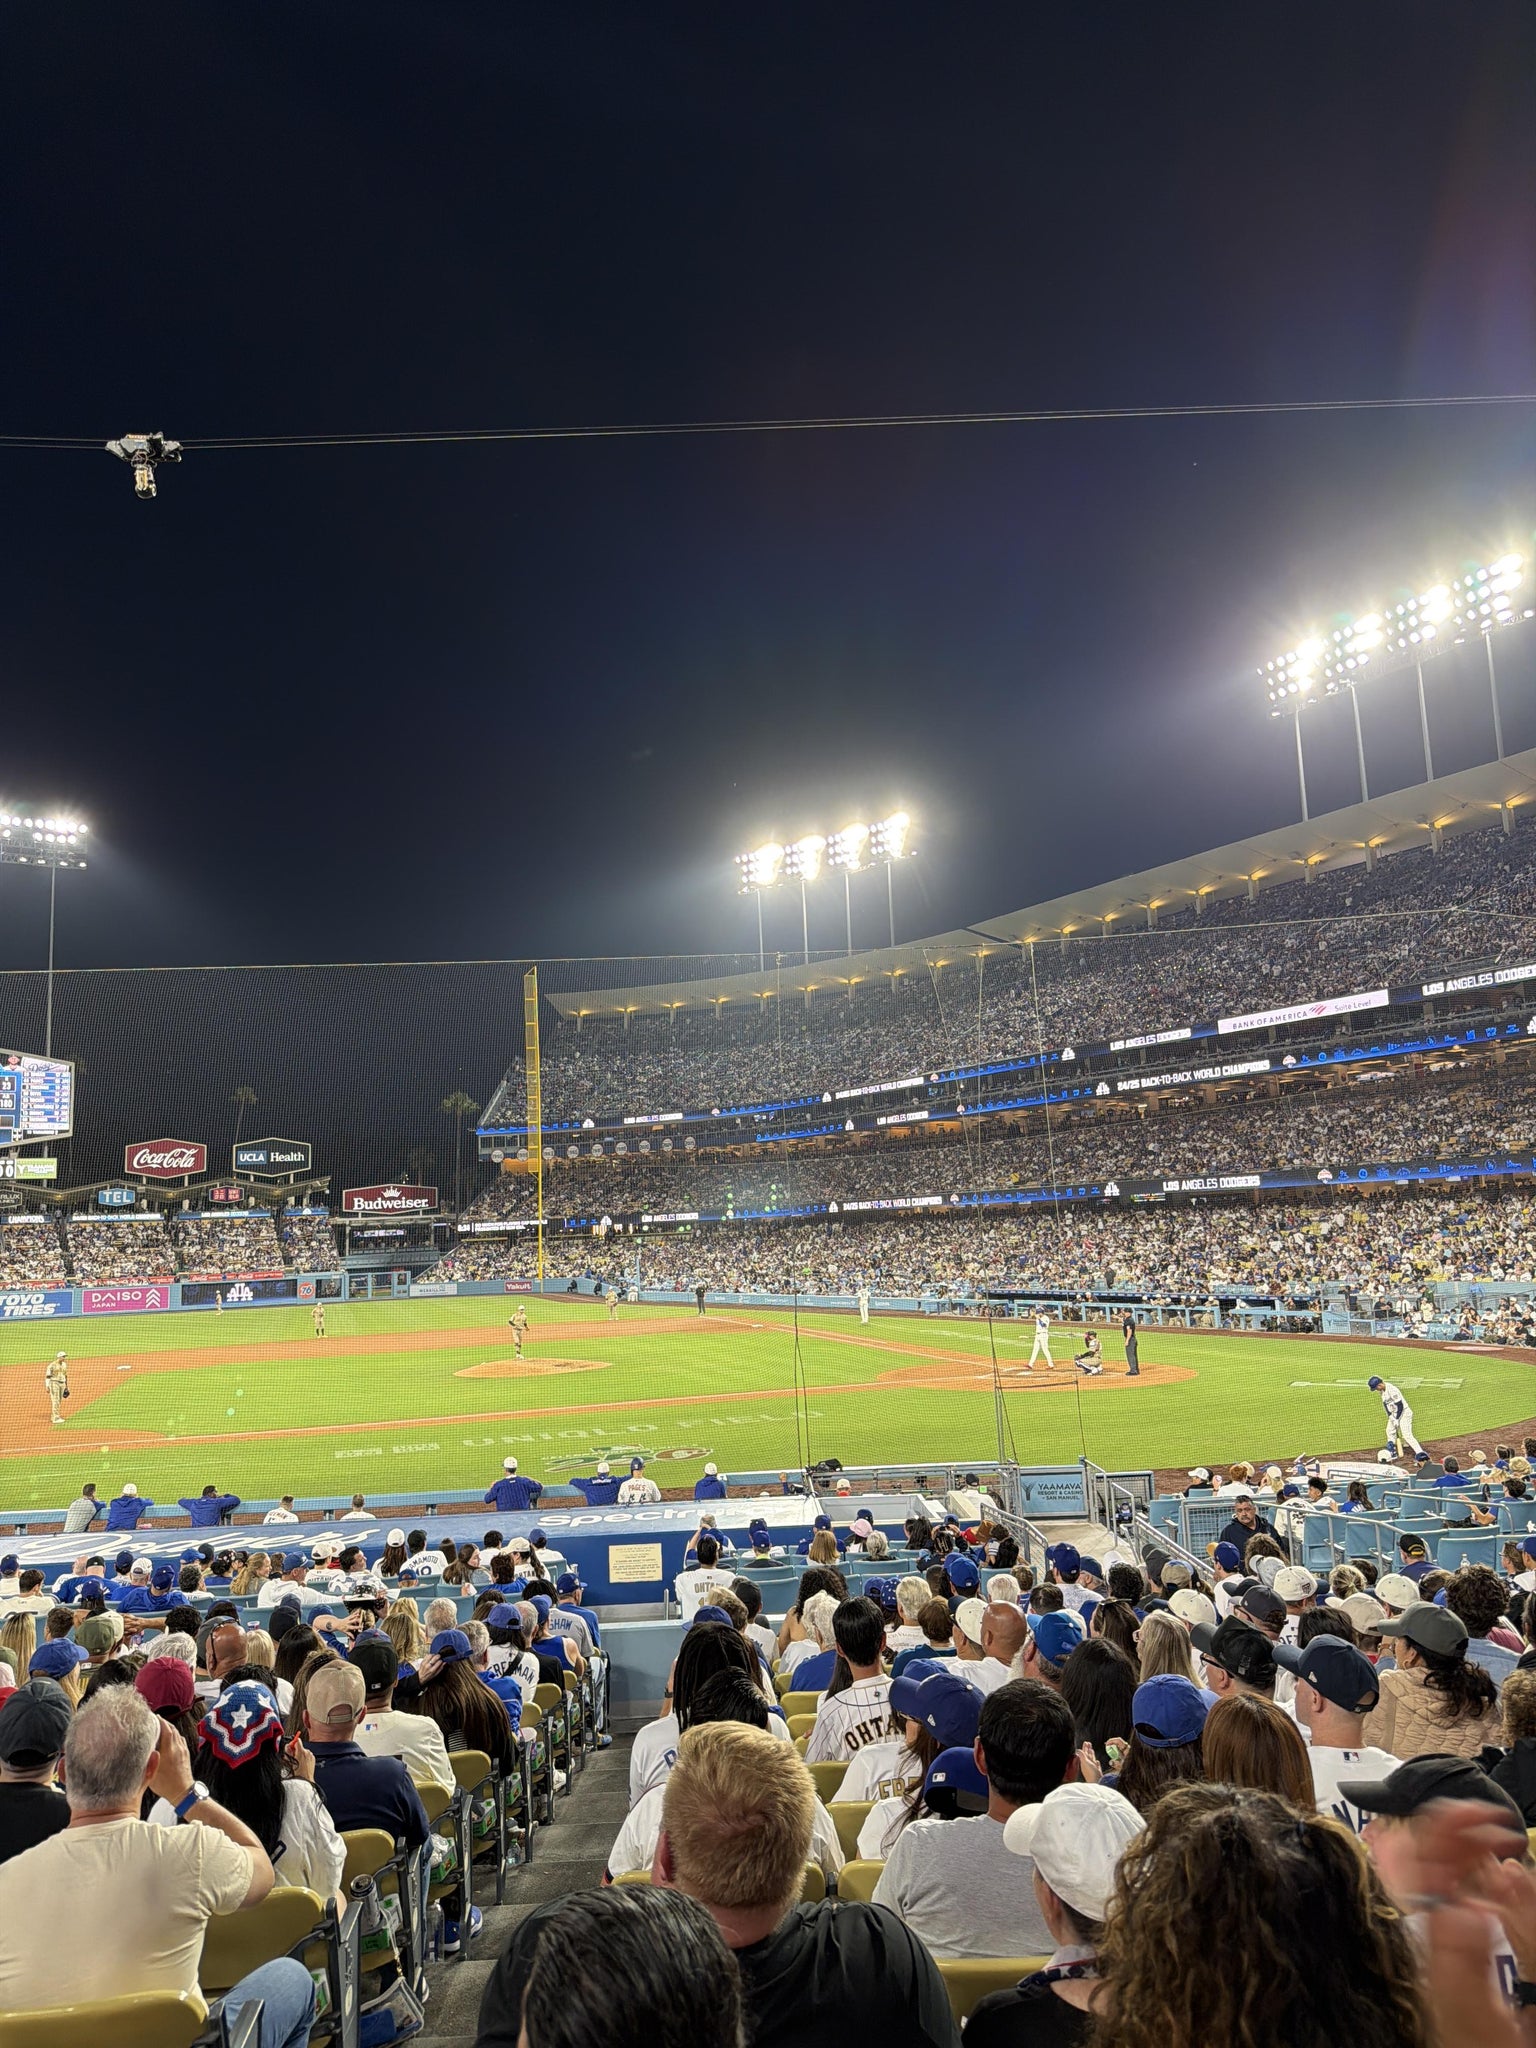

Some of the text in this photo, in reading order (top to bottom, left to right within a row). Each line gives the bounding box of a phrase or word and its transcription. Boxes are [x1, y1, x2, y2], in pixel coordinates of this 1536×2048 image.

[1422, 982, 1444, 996] LOS
[1446, 973, 1494, 992] ANGELES
[1232, 1020, 1255, 1030] BANK
[1256, 1018, 1268, 1026] OF
[1269, 1010, 1308, 1024] AMERICA
[1353, 999, 1372, 1010] Level
[1141, 1071, 1192, 1088] BACK-TO-BACK
[1192, 1066, 1220, 1080] WORLD
[1222, 1060, 1270, 1076] CHAMPIONS
[132, 1148, 199, 1168] Coca-Cola
[239, 1152, 304, 1162] UCLA Health
[1163, 1181, 1179, 1191] LOS
[1182, 1178, 1218, 1190] ANGELES
[103, 1191, 130, 1202] TEL
[92, 1291, 142, 1303] DAISO
[4, 1304, 56, 1316] TIRES
[463, 1410, 824, 1447] UNIQLO FIELD
[20, 1529, 380, 1566] Dodgers
[408, 1555, 438, 1570] AMAMOTO
[489, 1660, 535, 1684] FREMAN
[844, 1714, 906, 1751] OHTA
